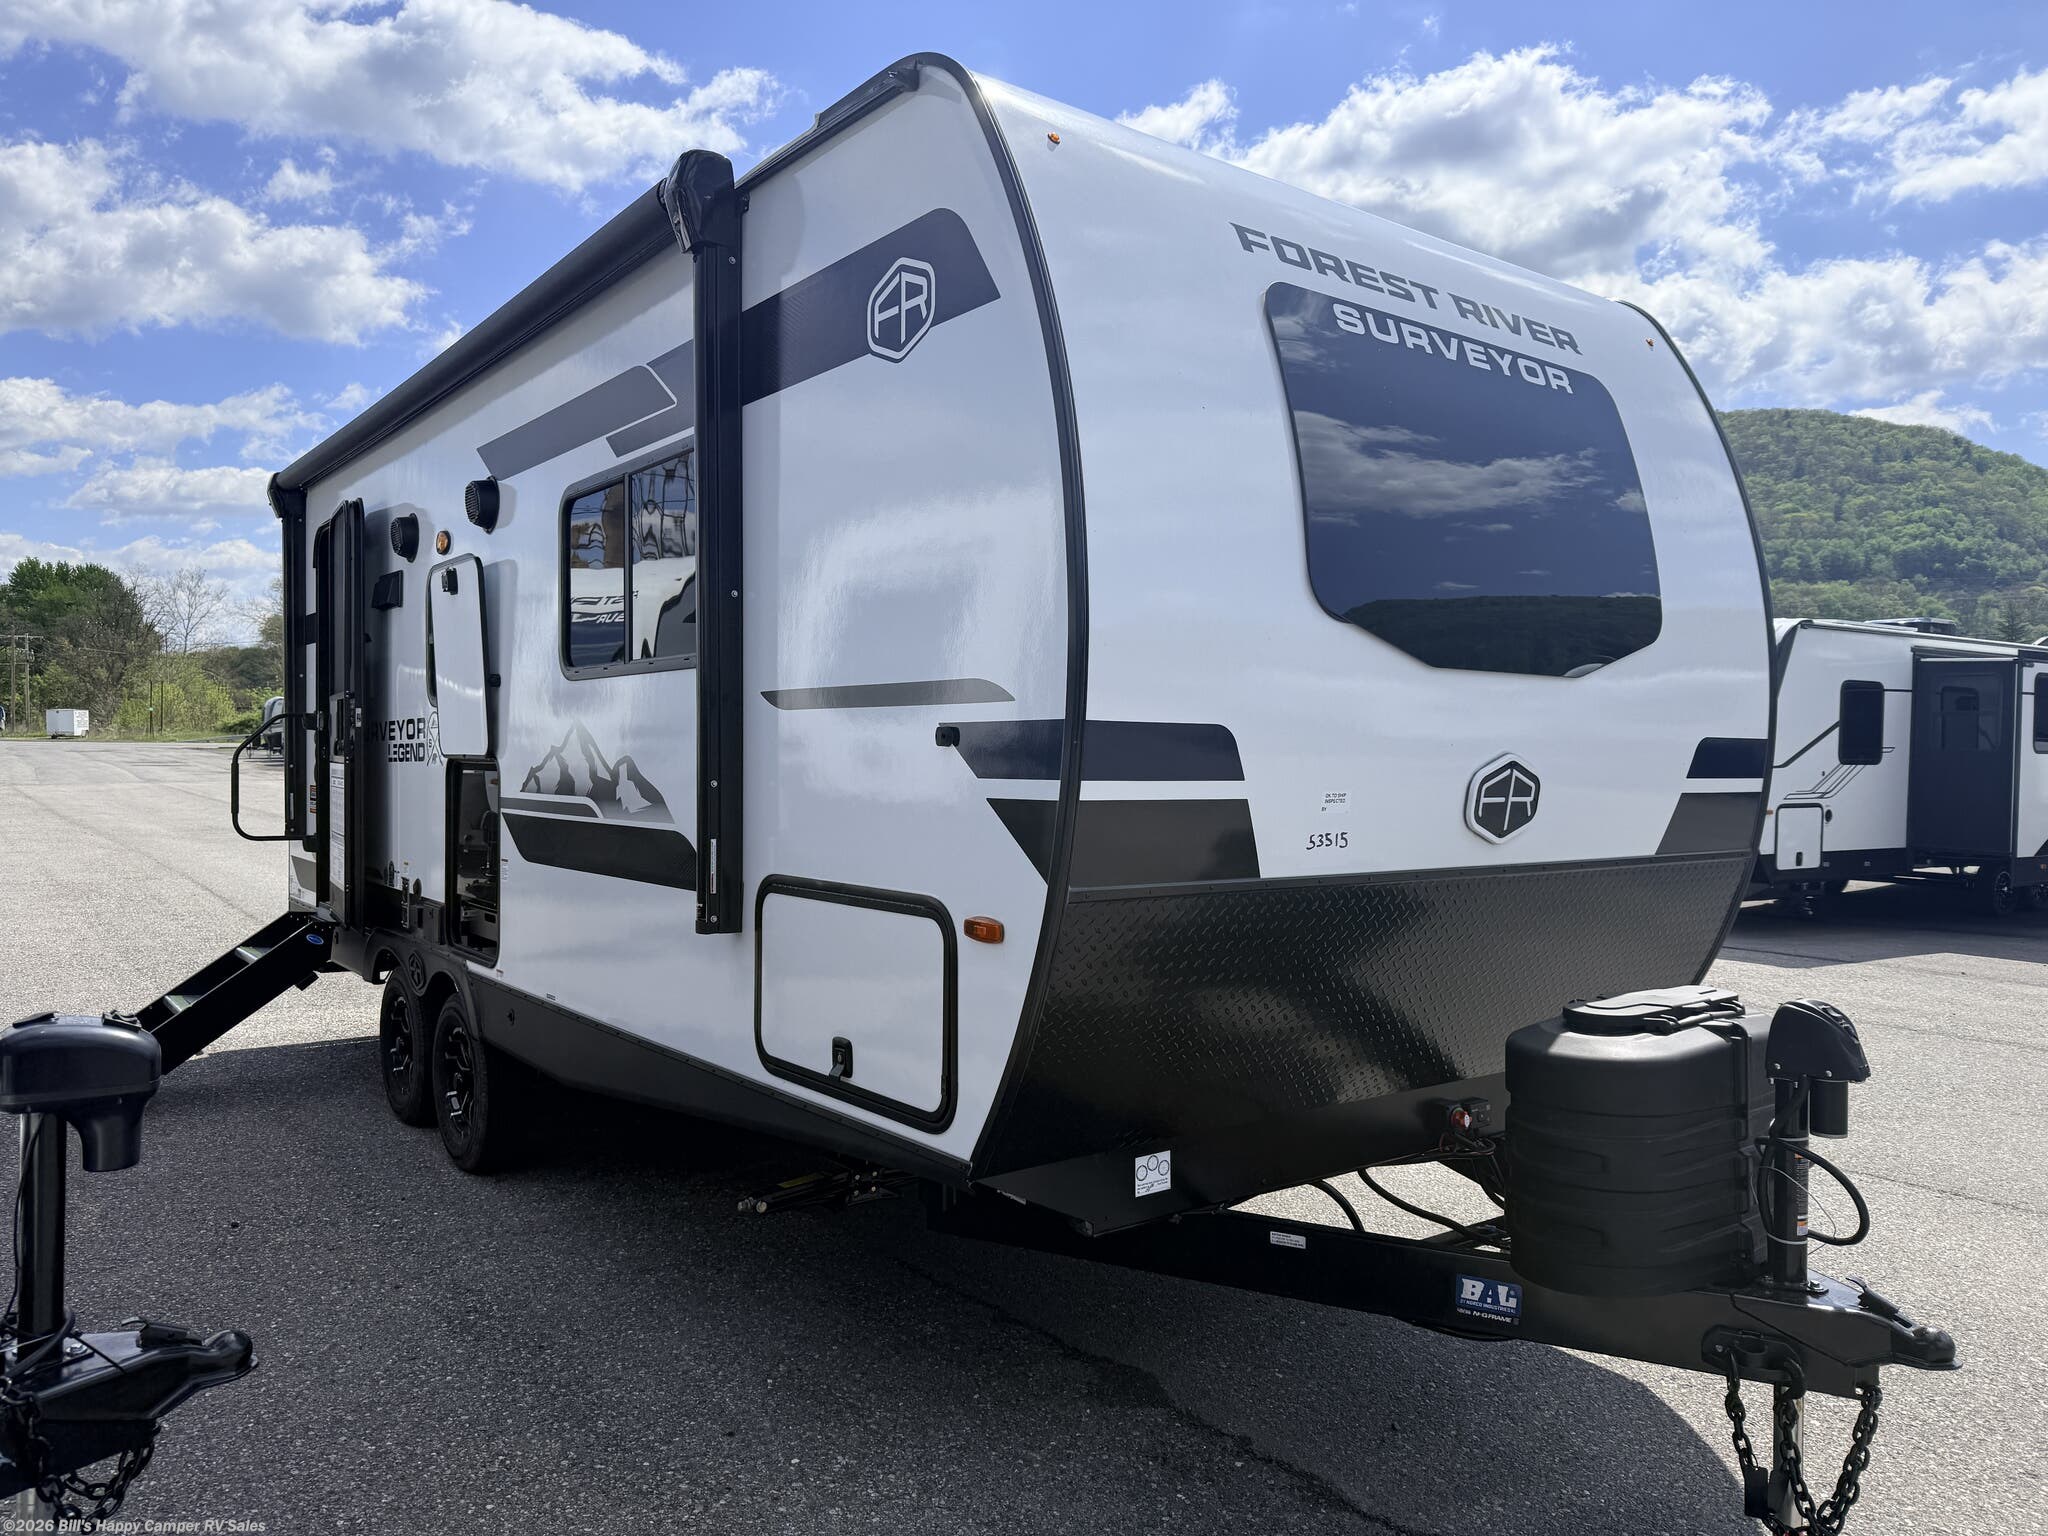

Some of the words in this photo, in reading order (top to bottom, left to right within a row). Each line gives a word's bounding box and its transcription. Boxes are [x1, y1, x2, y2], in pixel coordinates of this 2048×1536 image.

[1229, 222, 1439, 310] FOREST
[1447, 292, 1583, 355] RIVER
[1332, 303, 1574, 394] SURVEYOR
[388, 743, 426, 763] LEGEND
[1306, 831, 1348, 850] 53515
[1460, 1278, 1517, 1308] BAL
